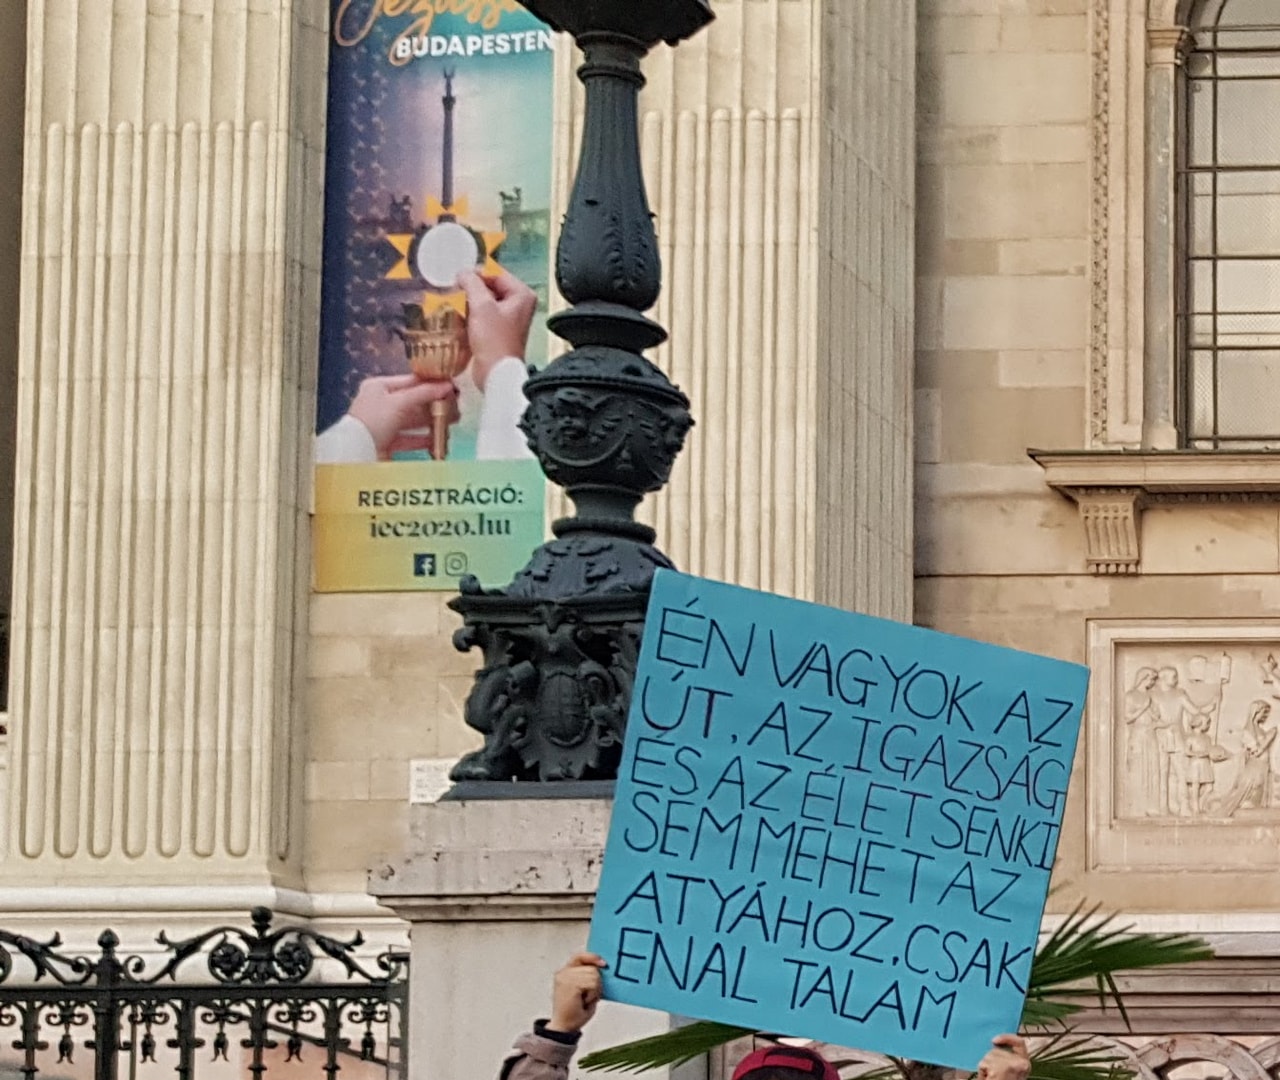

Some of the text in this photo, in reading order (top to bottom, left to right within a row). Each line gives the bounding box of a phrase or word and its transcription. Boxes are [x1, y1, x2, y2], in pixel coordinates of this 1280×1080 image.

[396, 30, 554, 58] BUDAPESTEN
[358, 482, 524, 507] REGISZTRÁCIÓ:
[370, 511, 512, 538] iec2020.hu
[656, 597, 1075, 748] ÉN VAGYOK AZ
[707, 755, 793, 812] AZ
[800, 763, 933, 838] ÉLET
[931, 799, 1060, 872] SENKI
[747, 701, 833, 763] AZ
[842, 715, 1066, 817] IGAZSÁG
[624, 791, 1022, 924] SEM MEHET AZ
[613, 926, 957, 1040] ENAL TALAM
[904, 924, 1032, 996] CSAK
